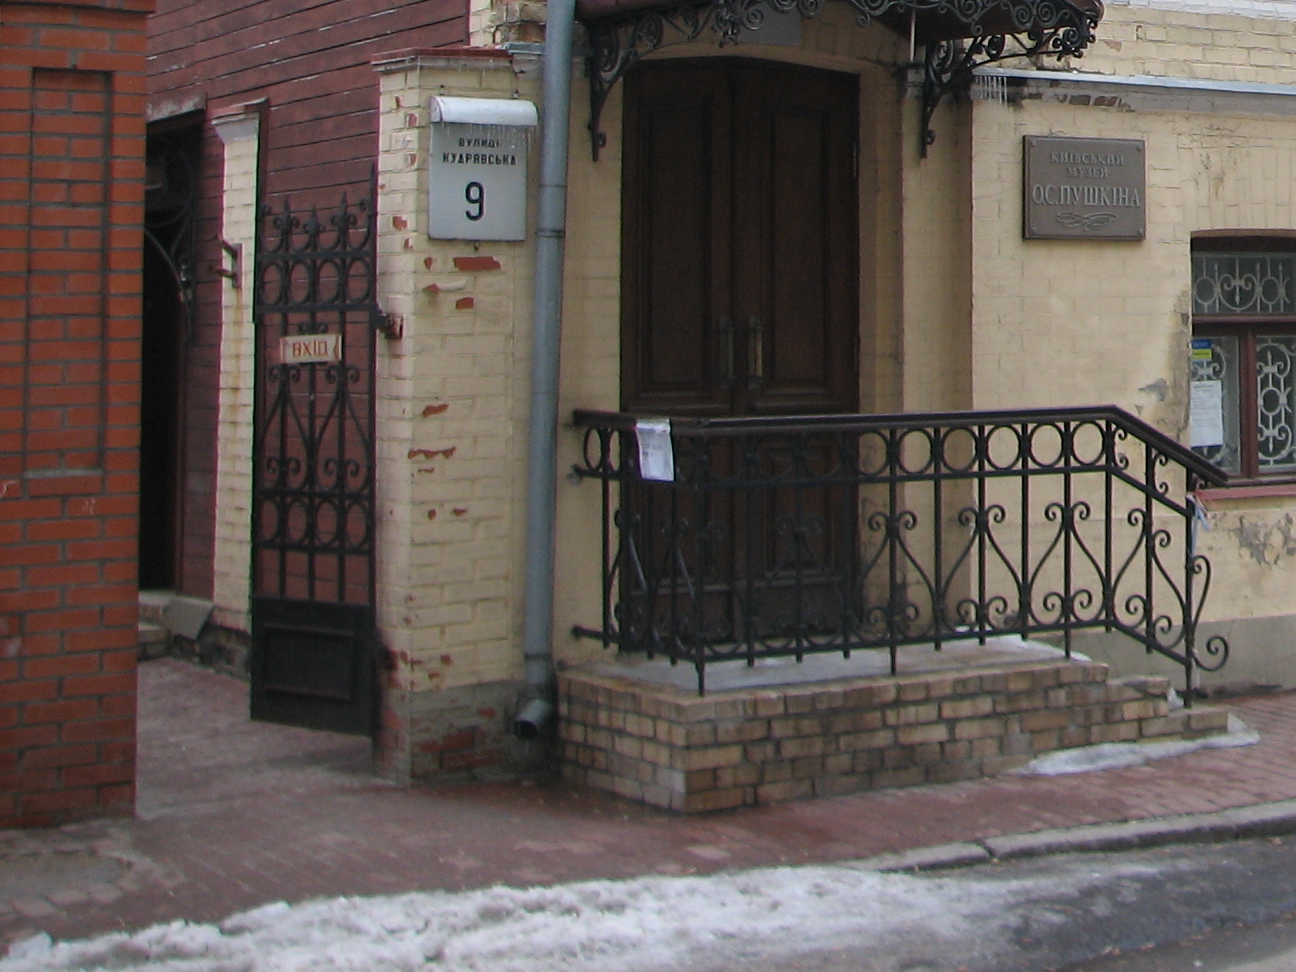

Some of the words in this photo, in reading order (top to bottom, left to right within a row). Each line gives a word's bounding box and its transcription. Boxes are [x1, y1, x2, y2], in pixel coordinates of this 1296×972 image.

[442, 152, 517, 165] КУДРЯВСЬКА
[1050, 151, 1125, 166] КИЇВСЬКИЙ
[1067, 166, 1108, 178] МУЗЕЙ
[465, 181, 485, 221] 9
[292, 339, 328, 358] ВХІД
